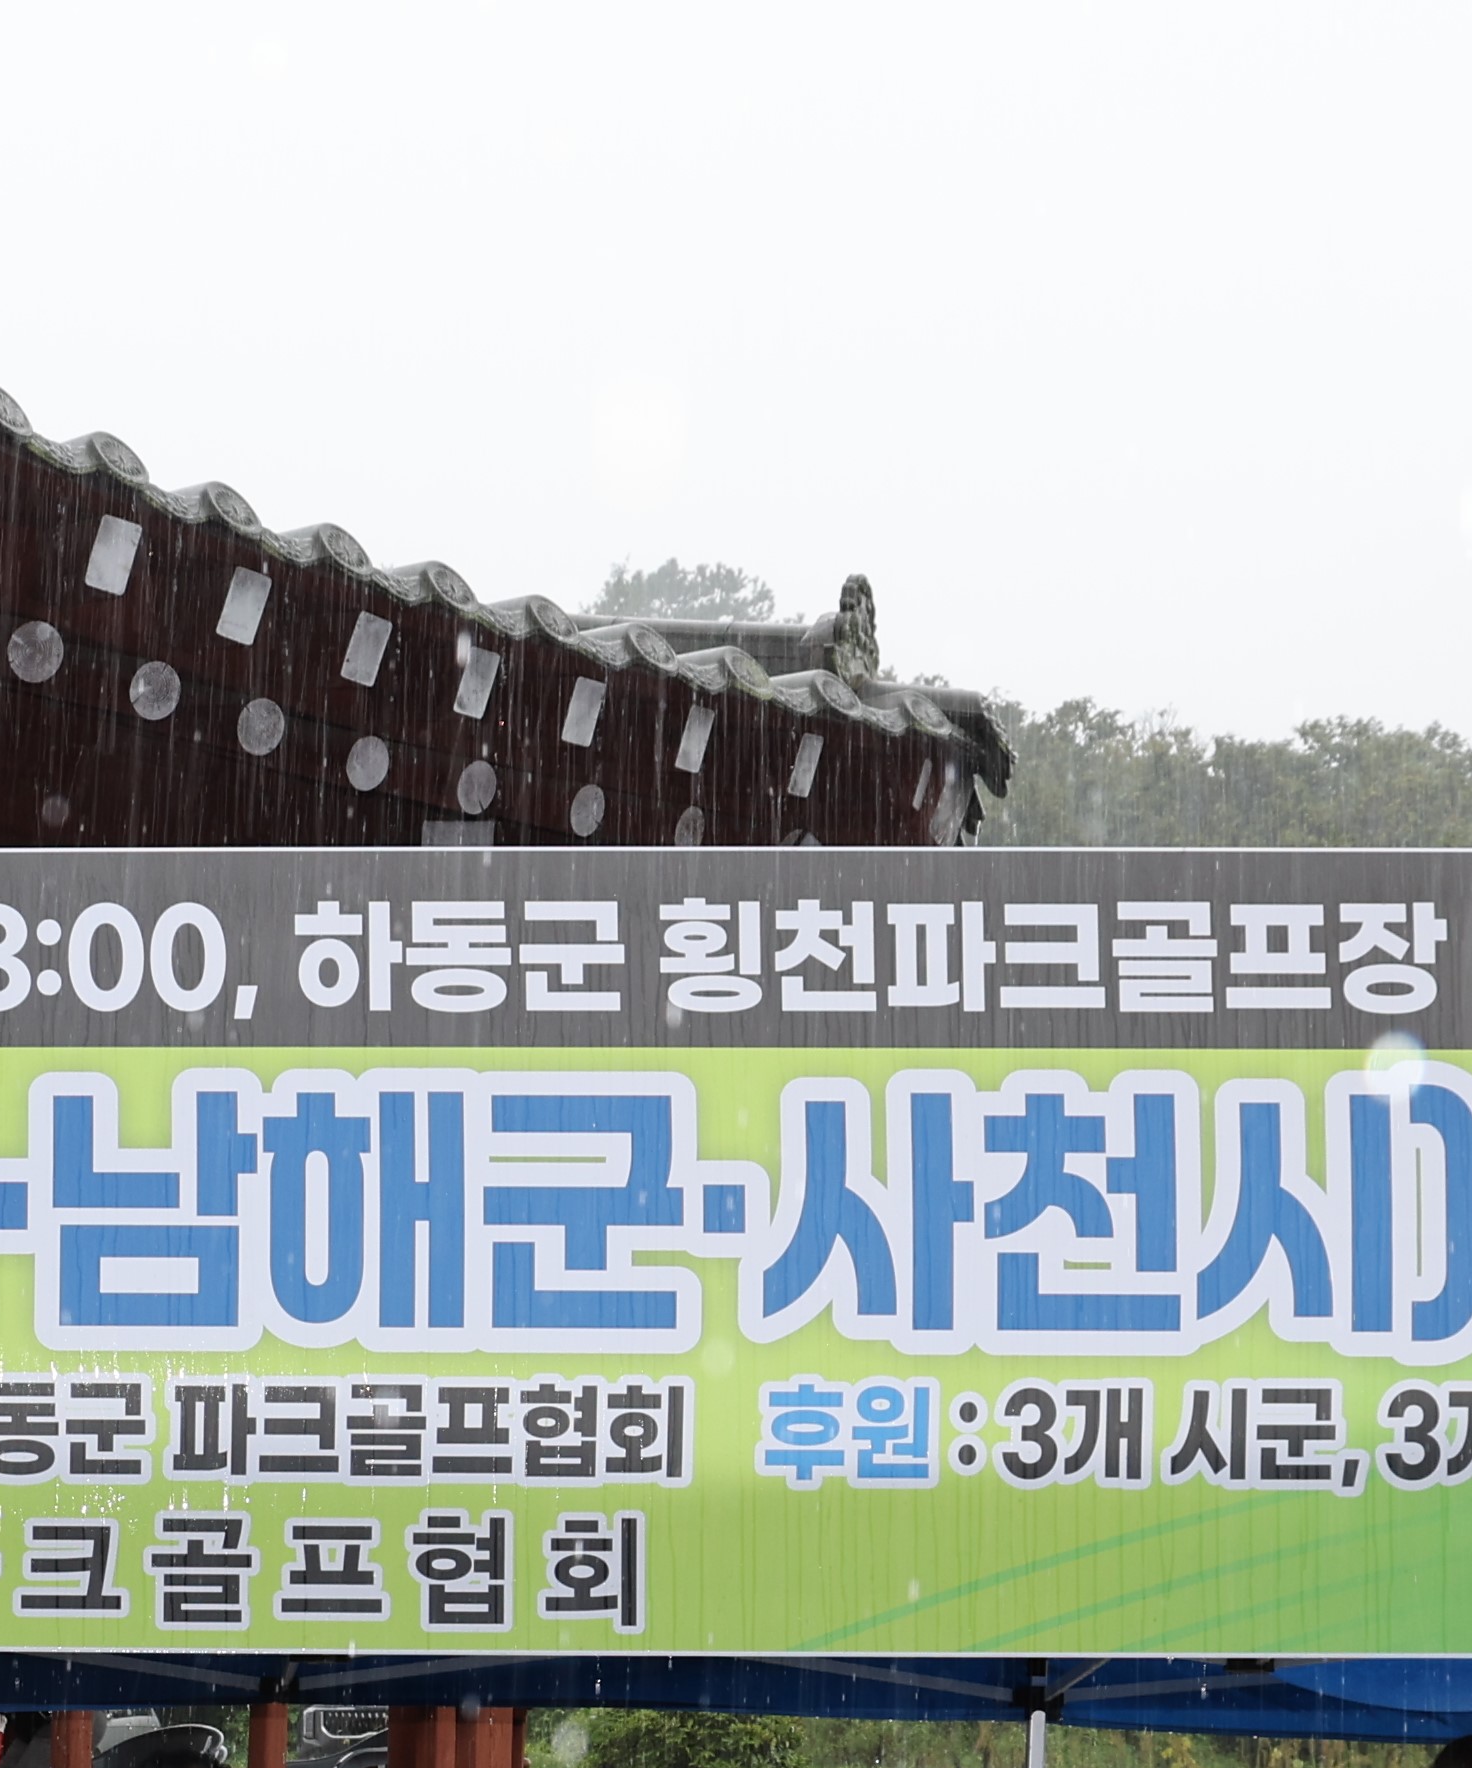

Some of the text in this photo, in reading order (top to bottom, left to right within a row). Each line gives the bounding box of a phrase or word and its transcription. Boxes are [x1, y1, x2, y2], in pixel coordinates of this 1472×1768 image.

[293, 899, 626, 1013] 하동군
[658, 896, 1447, 1016] 횡천파크골프장
[172, 1386, 685, 1480] 파크골프협회
[764, 1383, 931, 1482] 후원
[1001, 1388, 1146, 1481] 3개
